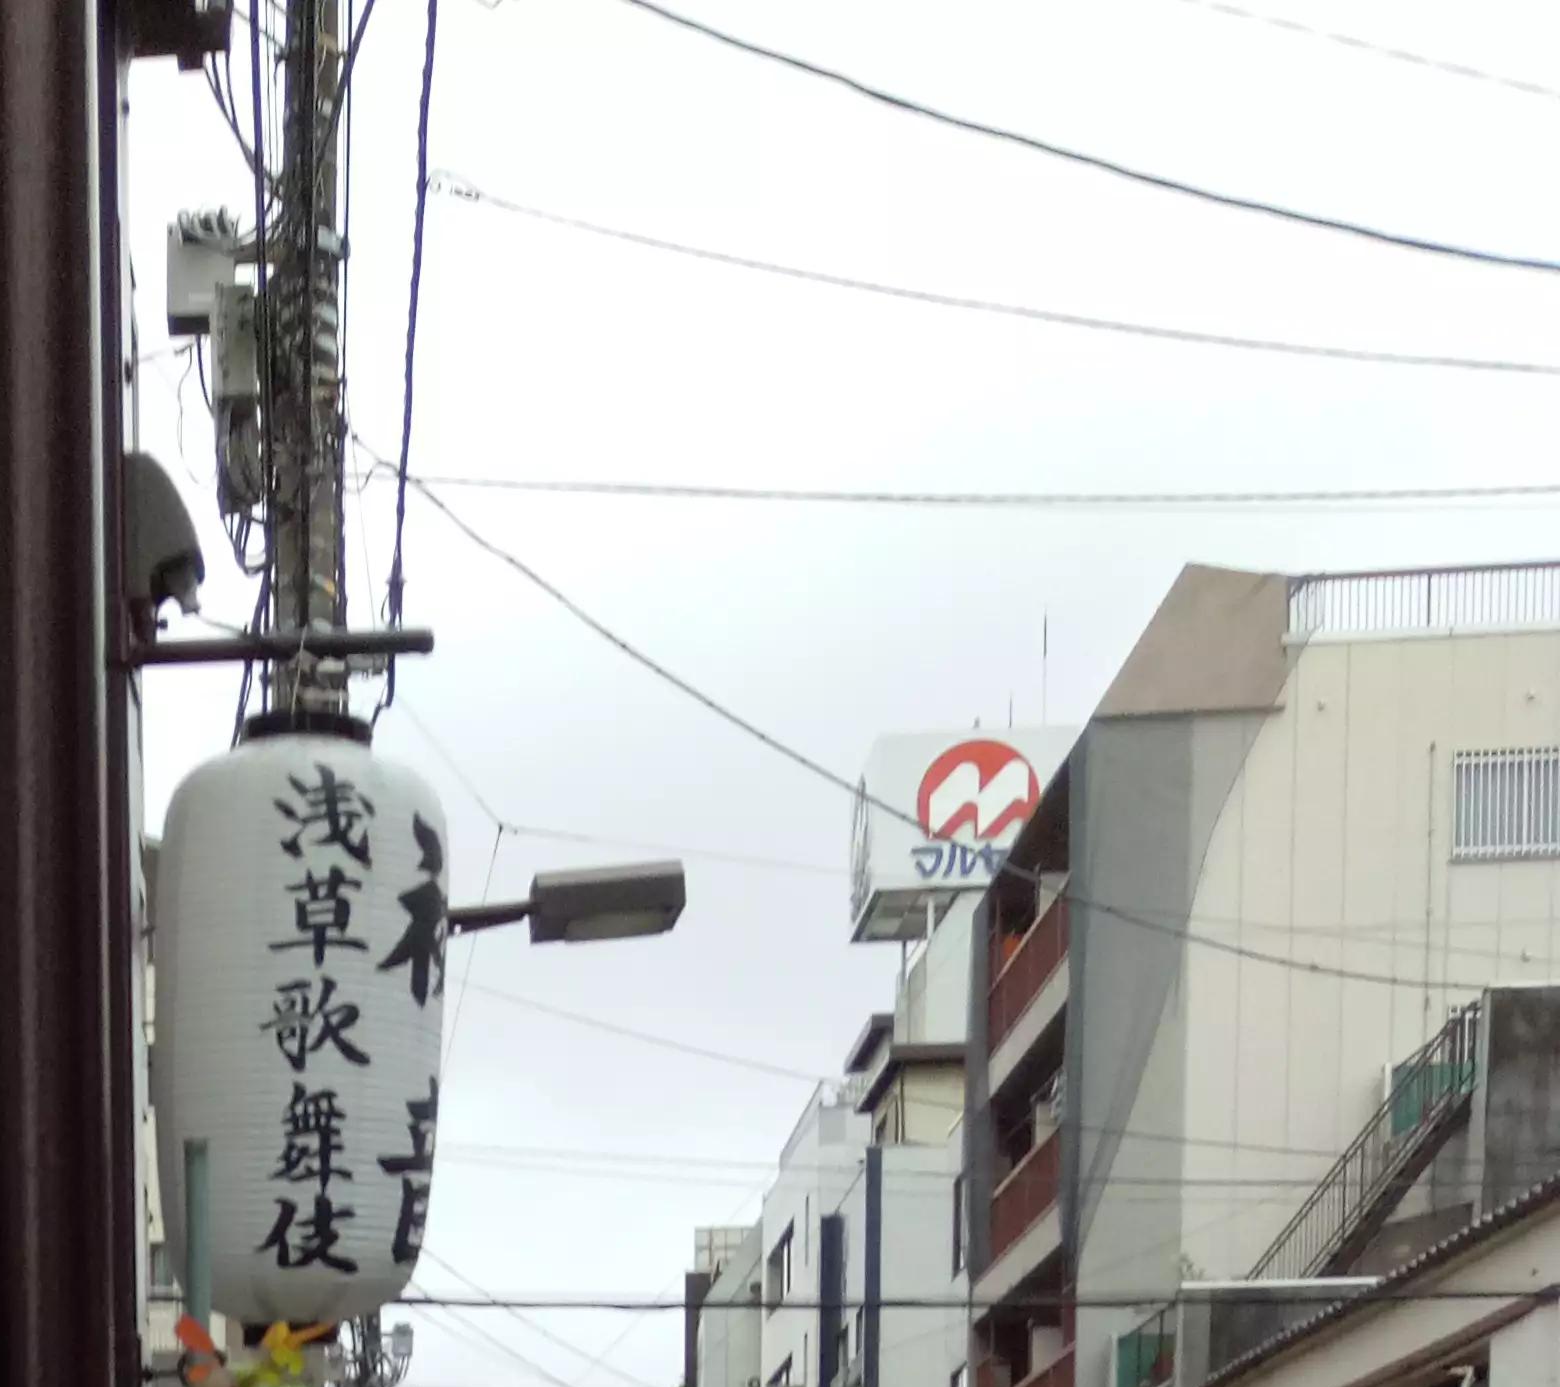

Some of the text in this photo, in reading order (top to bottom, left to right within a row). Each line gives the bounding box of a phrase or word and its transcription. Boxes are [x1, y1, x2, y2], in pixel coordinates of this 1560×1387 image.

[254, 761, 376, 1275] 浅草歌舞伎
